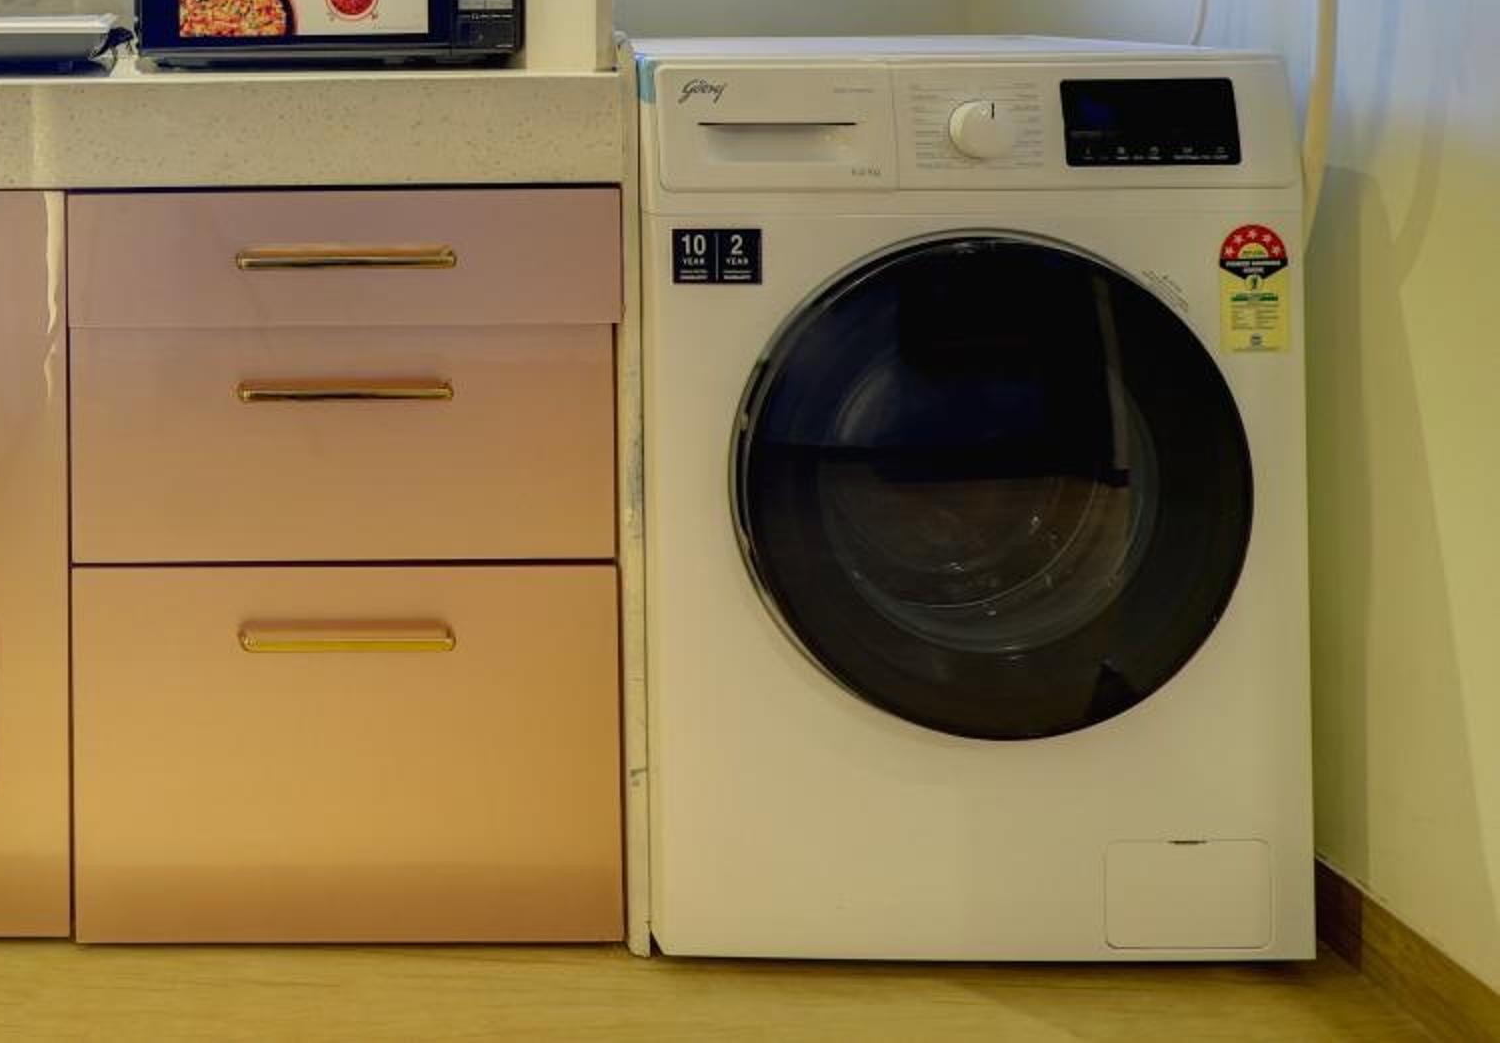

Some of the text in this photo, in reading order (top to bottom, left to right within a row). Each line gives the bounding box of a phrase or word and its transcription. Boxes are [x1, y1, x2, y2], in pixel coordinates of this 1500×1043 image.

[681, 234, 707, 255] 10
[731, 234, 743, 255] 2
[726, 258, 749, 266] YEAR
